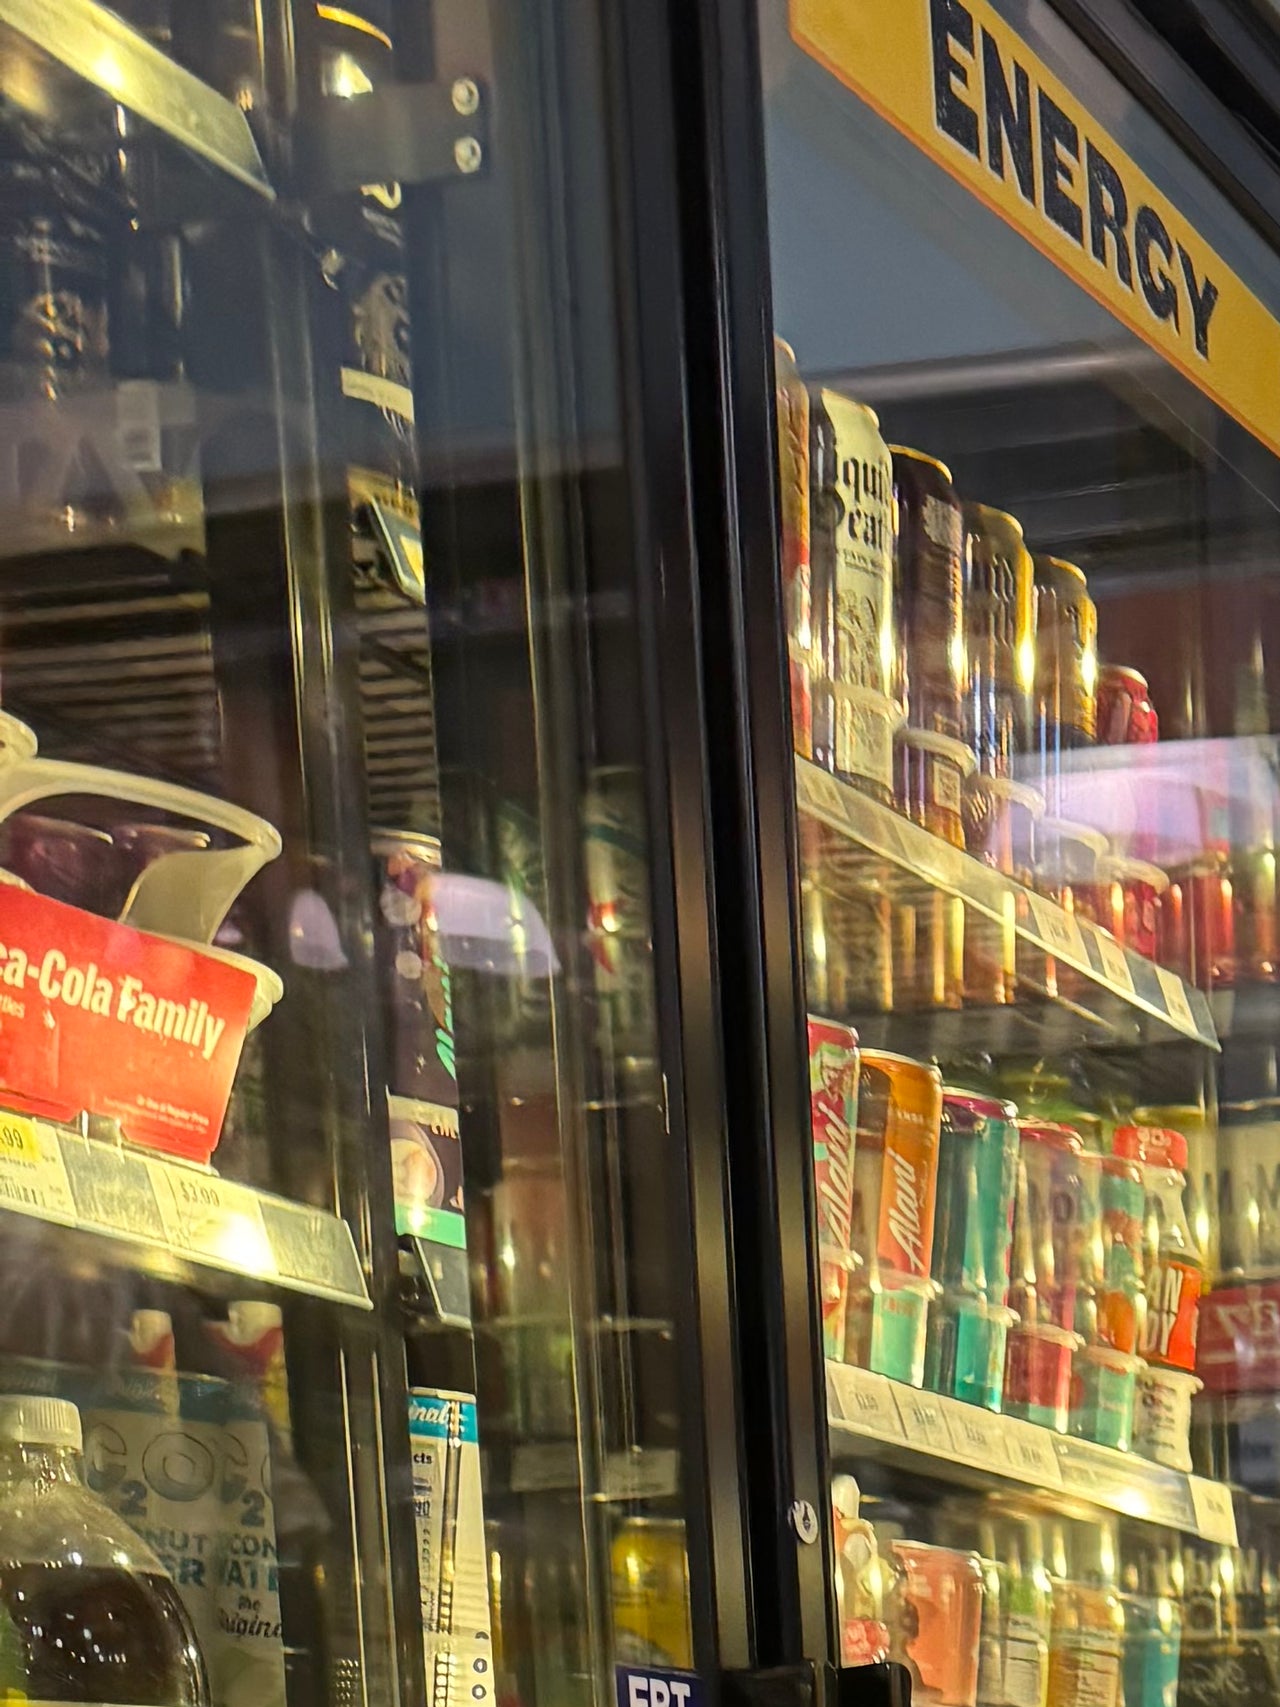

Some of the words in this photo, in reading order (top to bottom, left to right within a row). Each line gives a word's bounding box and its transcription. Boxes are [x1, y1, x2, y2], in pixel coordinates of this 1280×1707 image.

[930, 0, 1218, 361] ENERGY
[117, 974, 225, 1061] Family
[817, 1100, 852, 1246] Alani
[886, 1148, 924, 1271] Alani
